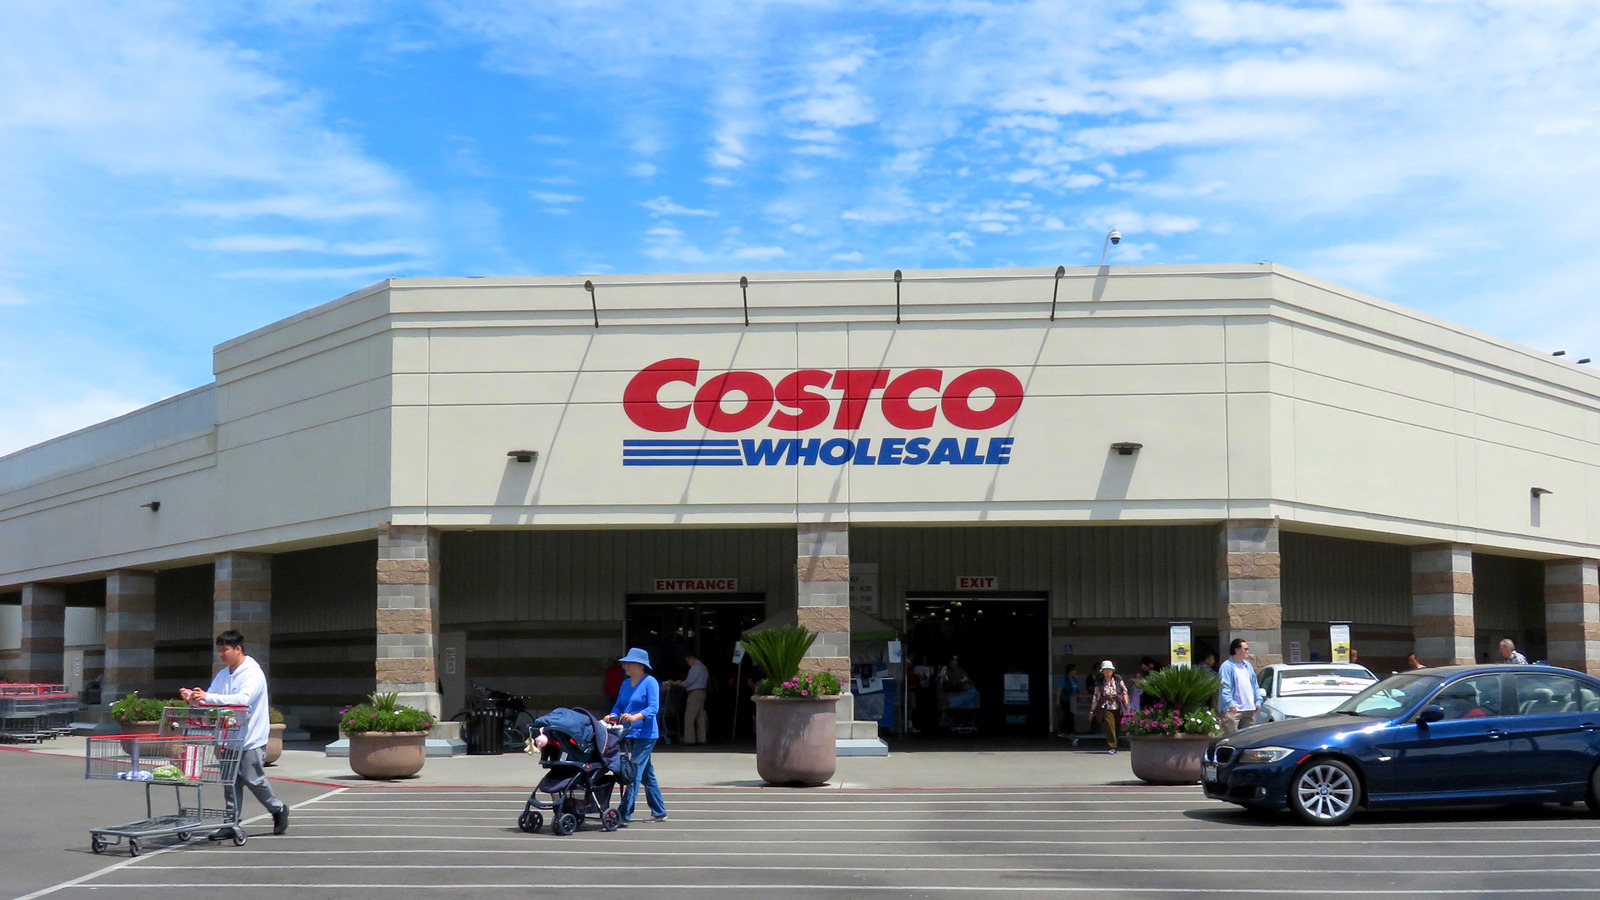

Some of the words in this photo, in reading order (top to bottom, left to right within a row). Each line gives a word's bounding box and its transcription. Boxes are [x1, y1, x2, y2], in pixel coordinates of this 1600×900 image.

[623, 357, 1024, 433] COSTCO
[741, 437, 1015, 466] WHOLESALE
[656, 579, 736, 591] ENTRANCE
[960, 578, 994, 588] EXIT
